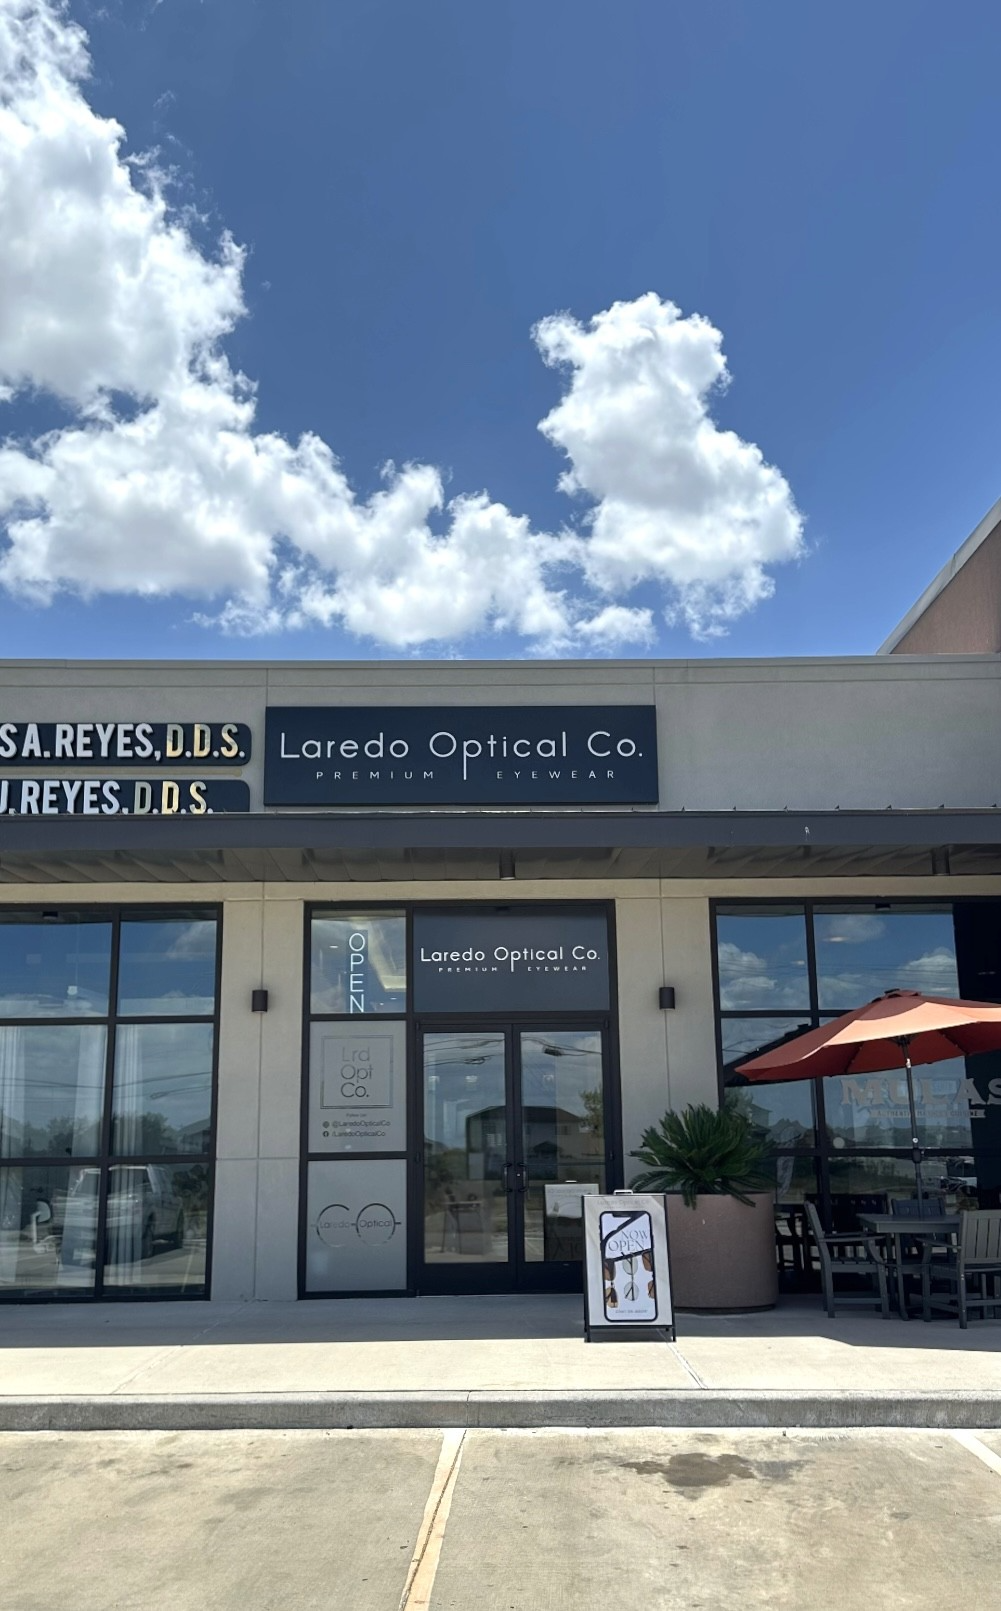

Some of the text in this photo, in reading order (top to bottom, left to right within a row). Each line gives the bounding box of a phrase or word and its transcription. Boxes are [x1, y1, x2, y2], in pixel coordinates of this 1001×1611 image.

[22, 723, 51, 757] A.
[55, 723, 161, 761] REYES,
[166, 723, 246, 757] D.D.S.
[280, 731, 643, 780] Laredo Optical Co.
[316, 770, 615, 779] PREMIUM EYEWEAR
[134, 780, 214, 814] D.D.S.
[420, 945, 601, 972] Laredo Optical Co.
[348, 932, 366, 1014] OPEN
[342, 1046, 370, 1062] Lrd
[341, 1064, 373, 1083] Opt
[341, 1082, 370, 1098] Co.
[360, 1219, 392, 1229] Optical
[620, 1230, 648, 1240] NOW
[608, 1240, 645, 1252] OPEN
